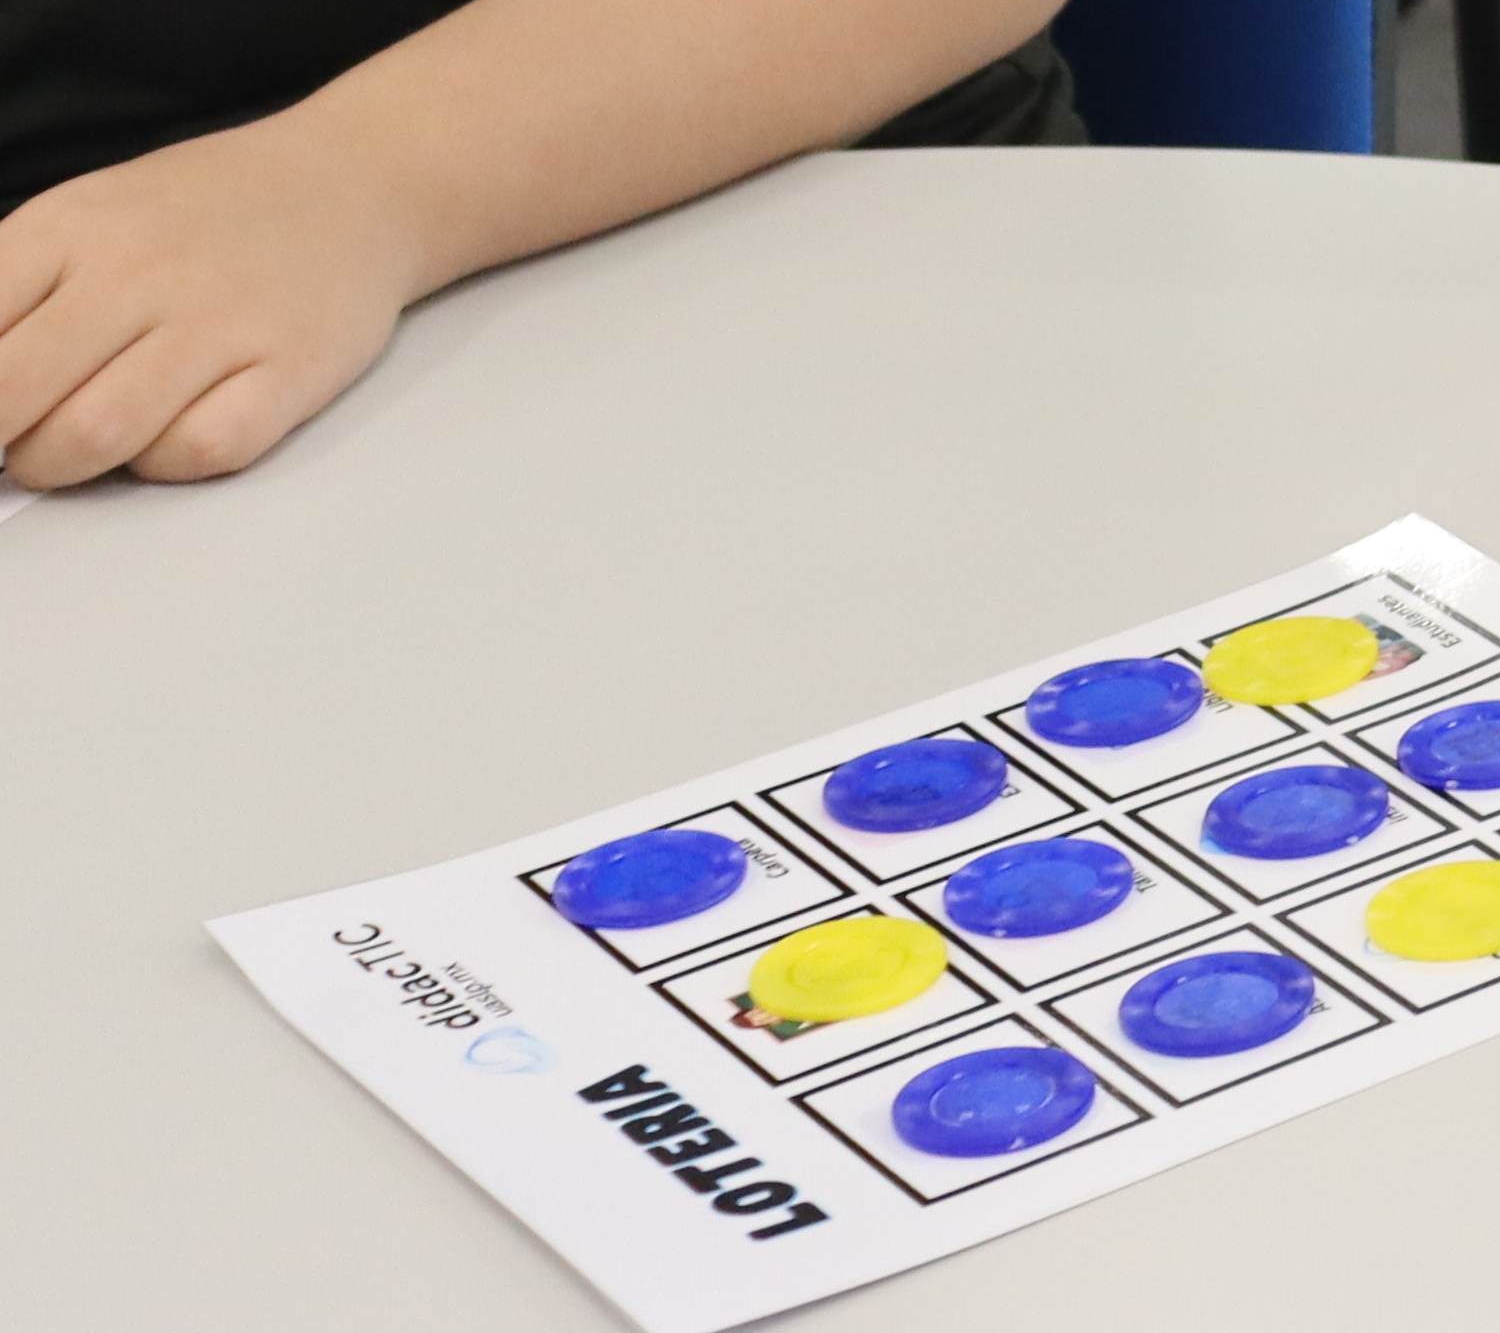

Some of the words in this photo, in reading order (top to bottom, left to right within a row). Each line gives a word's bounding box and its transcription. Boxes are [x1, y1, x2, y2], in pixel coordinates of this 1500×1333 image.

[1378, 594, 1462, 648] Estudiantes
[333, 923, 481, 1029] didacTIC
[441, 961, 514, 1018] uaslp.mx
[576, 1064, 831, 1241] LOTERIA
